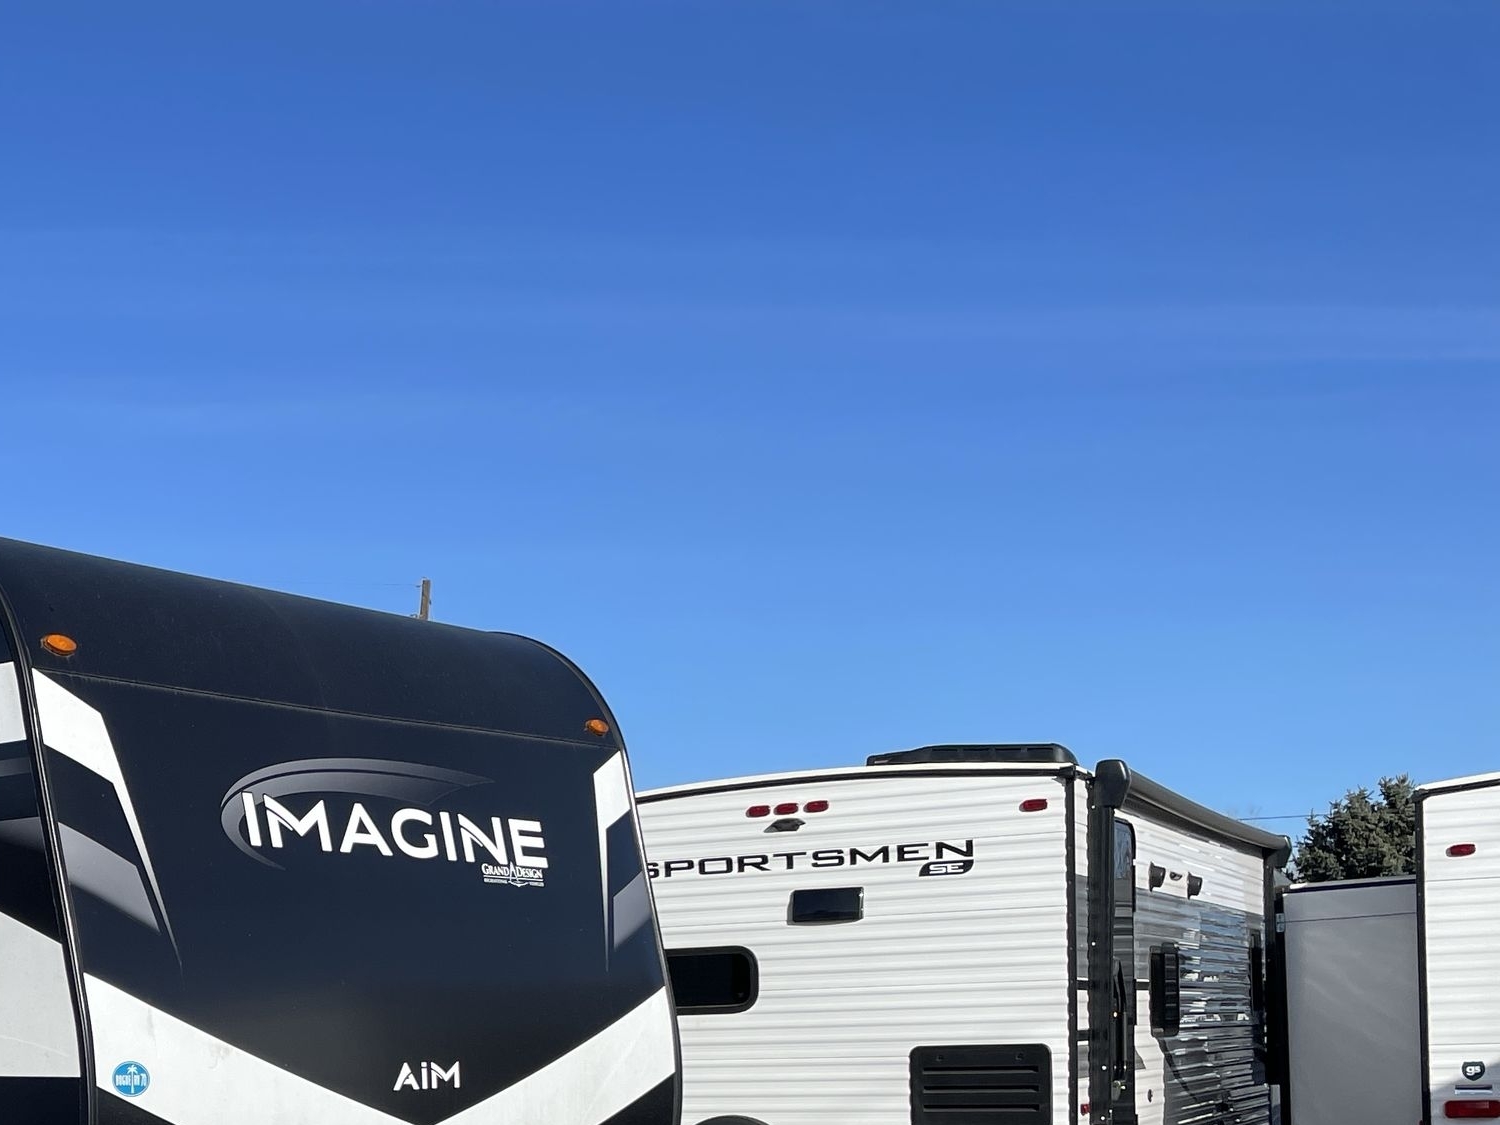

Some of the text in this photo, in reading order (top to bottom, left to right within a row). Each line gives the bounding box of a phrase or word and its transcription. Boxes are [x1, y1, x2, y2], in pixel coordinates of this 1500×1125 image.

[241, 792, 548, 868] IMAGINE
[481, 863, 543, 879] GRAND DESIGN
[647, 840, 973, 878] SPORTSMEN
[929, 863, 964, 874] SE
